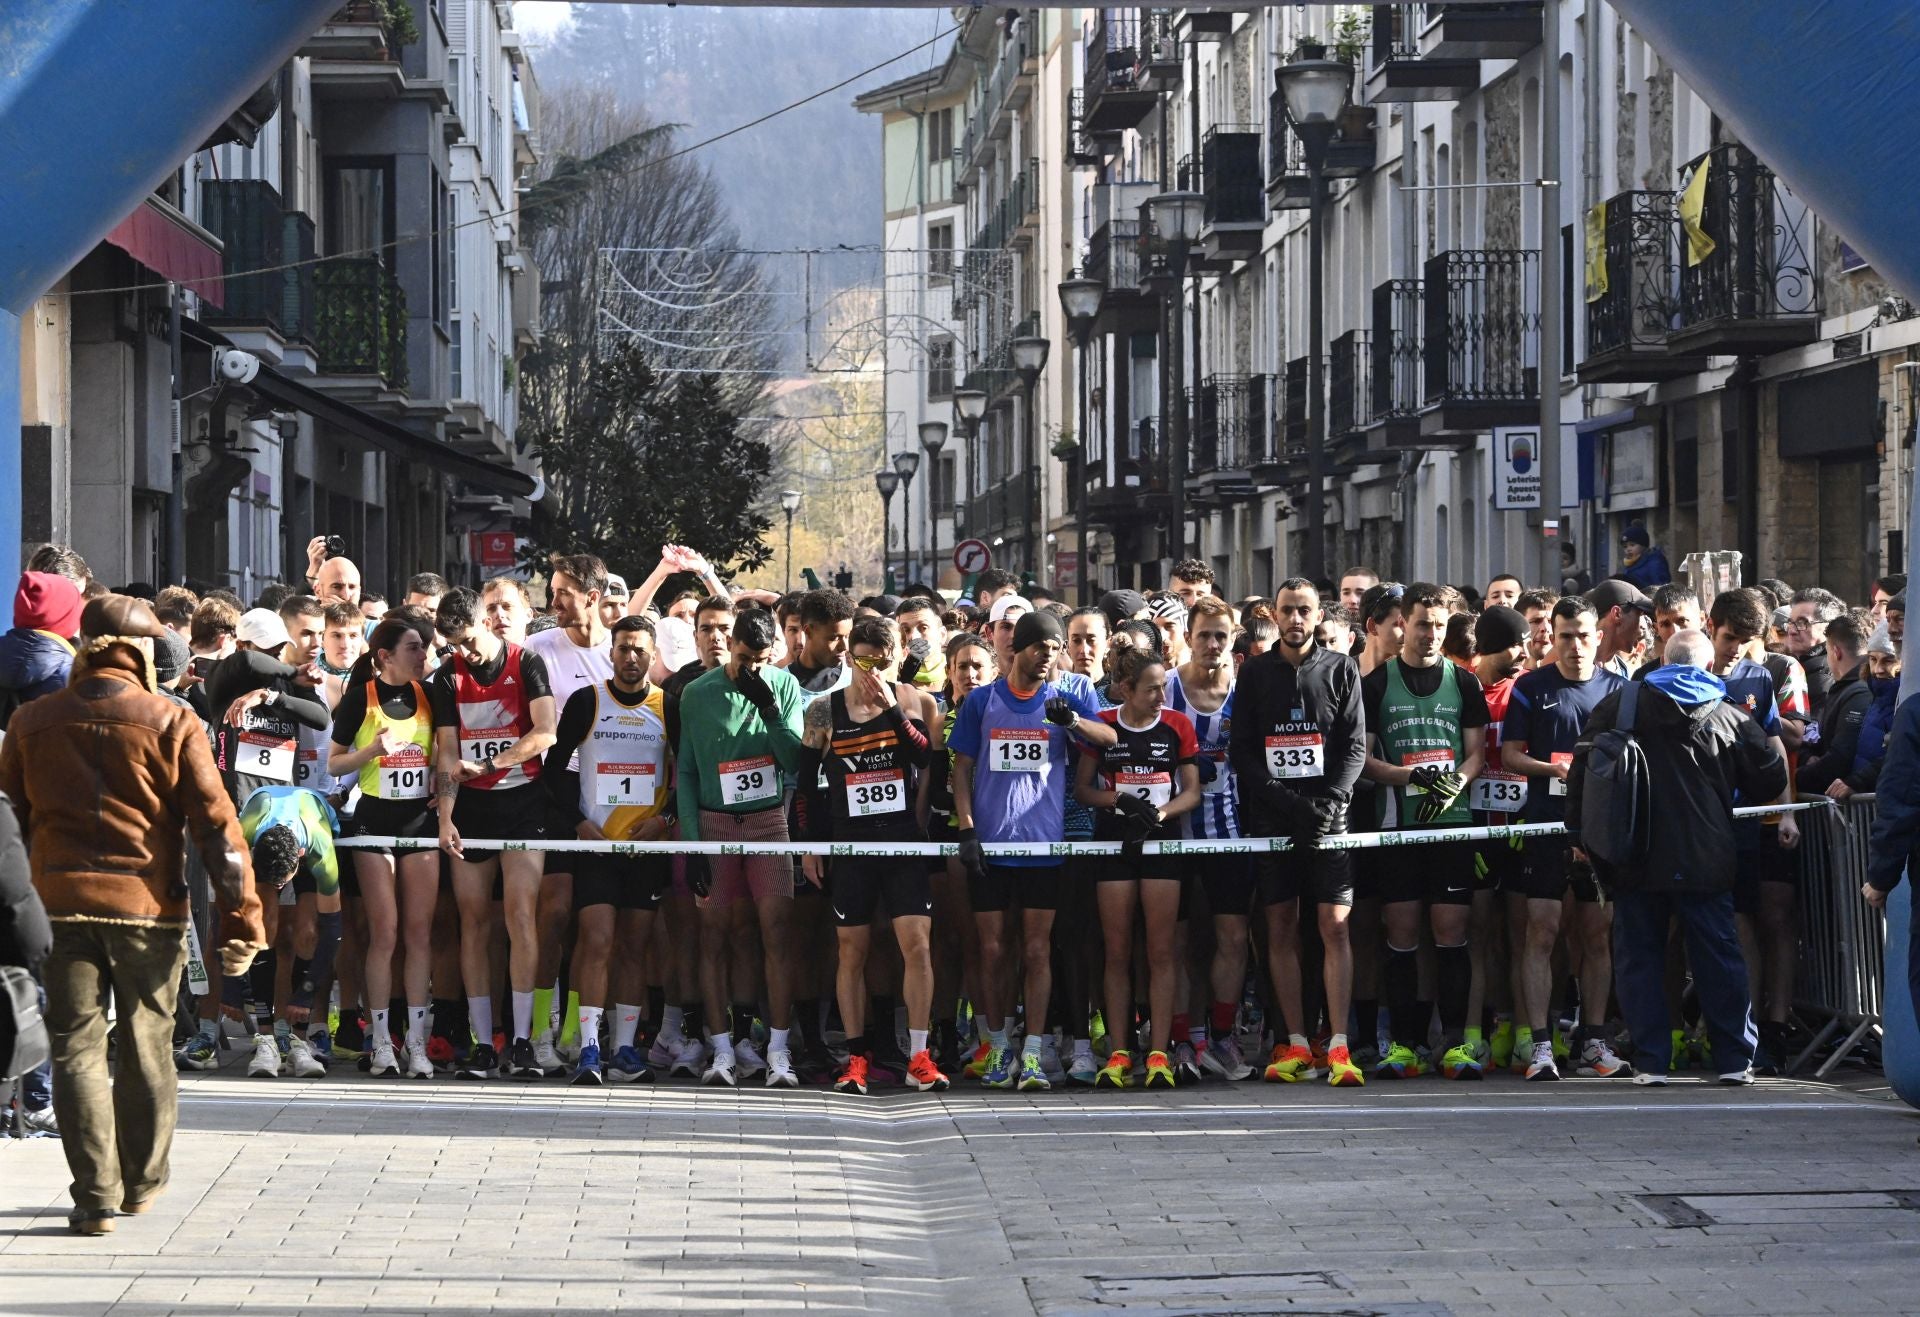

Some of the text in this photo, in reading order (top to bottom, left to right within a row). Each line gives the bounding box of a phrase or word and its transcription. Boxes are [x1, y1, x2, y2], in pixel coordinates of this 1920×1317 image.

[1507, 485, 1540, 494] Apuesta
[1507, 494, 1535, 502] Estado
[1275, 722, 1318, 732] MOYUA
[593, 731, 655, 741] grupompleo
[258, 749, 271, 766] 8
[864, 752, 894, 763] VICKY
[999, 743, 1042, 760] 138
[1273, 748, 1316, 767] 333
[868, 761, 892, 770] FOODS
[388, 769, 423, 788] 101
[620, 777, 630, 795] 1
[736, 771, 763, 791] 39
[855, 784, 898, 804] 389
[1137, 788, 1151, 801] 2
[1480, 782, 1520, 801] 133
